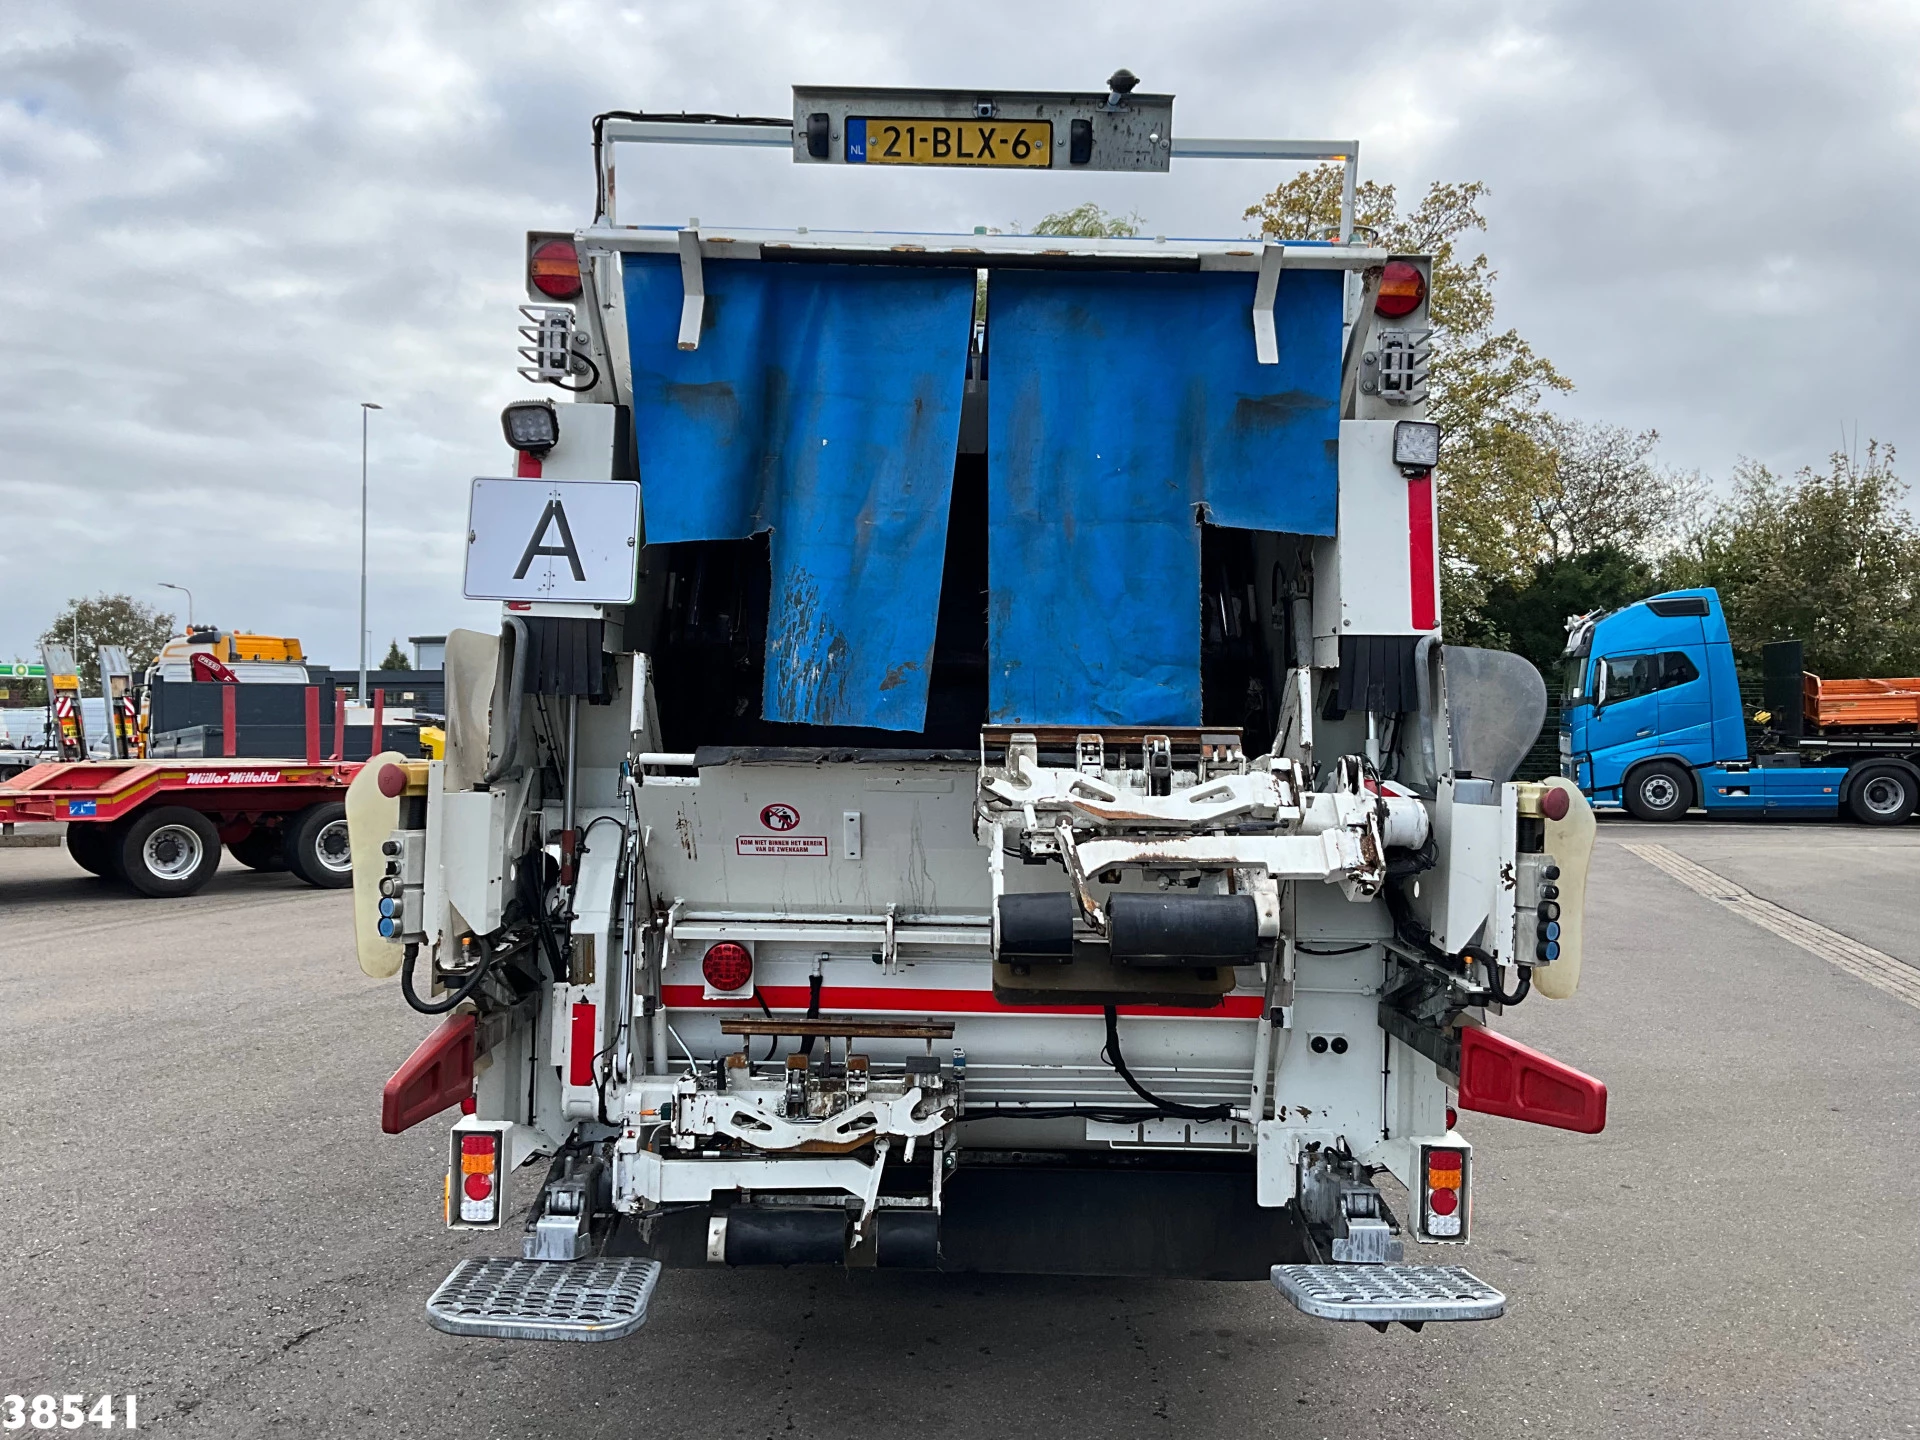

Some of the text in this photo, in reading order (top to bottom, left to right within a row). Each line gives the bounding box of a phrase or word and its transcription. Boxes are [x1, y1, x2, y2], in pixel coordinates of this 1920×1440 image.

[850, 144, 864, 155] NL
[883, 126, 1031, 160] 21-BLX-6
[512, 499, 586, 582] A
[186, 771, 281, 785] Müller Mitteltal
